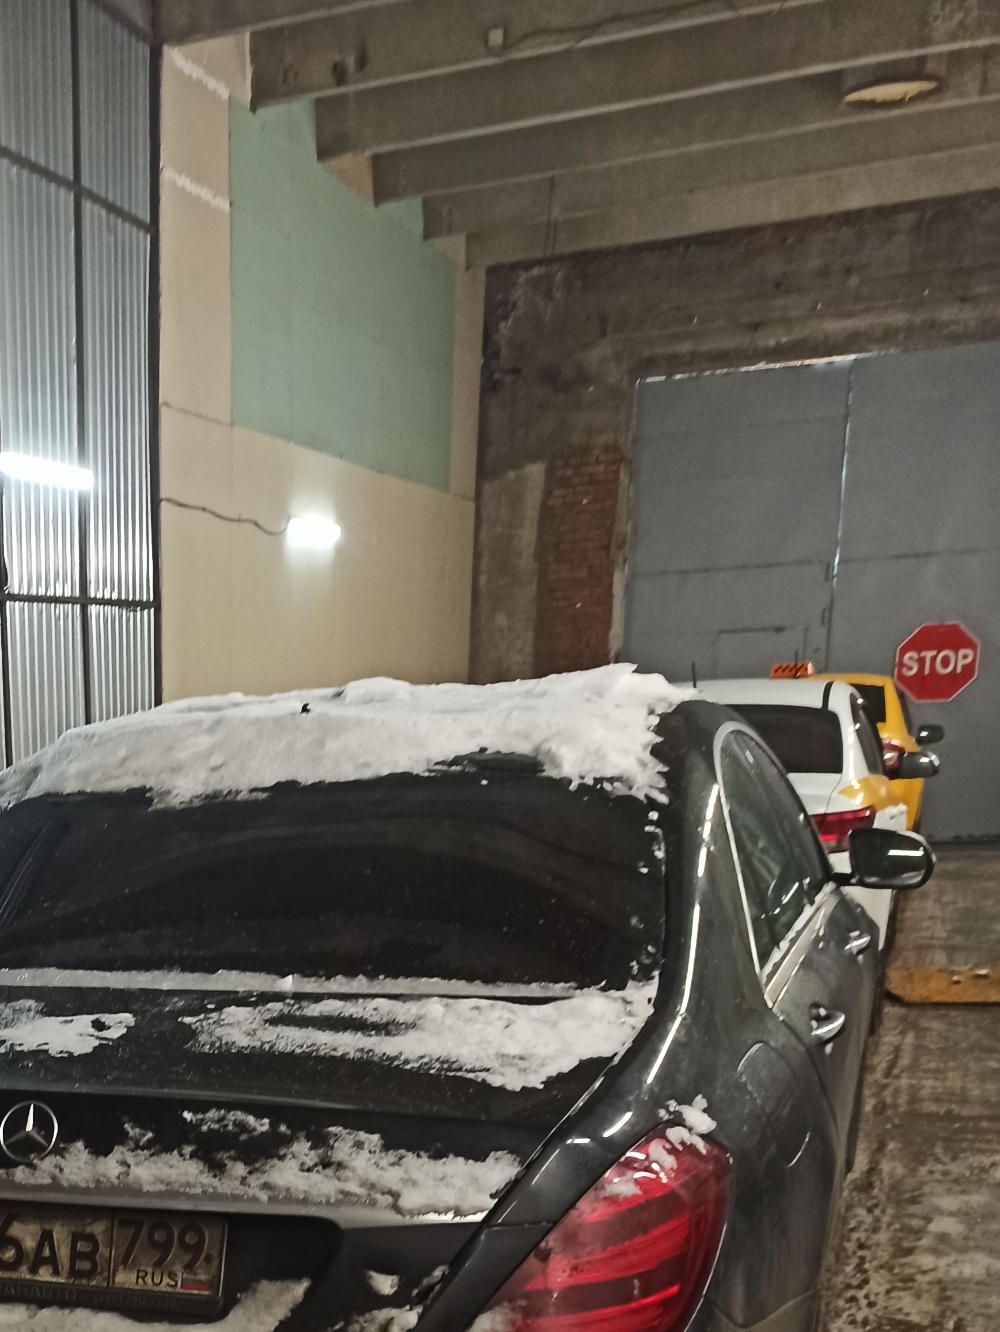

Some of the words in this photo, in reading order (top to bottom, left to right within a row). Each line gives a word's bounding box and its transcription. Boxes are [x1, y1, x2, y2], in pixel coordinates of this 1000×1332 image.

[902, 648, 975, 676] STOP
[117, 1218, 208, 1271] 799
[136, 1269, 179, 1289] RUS
